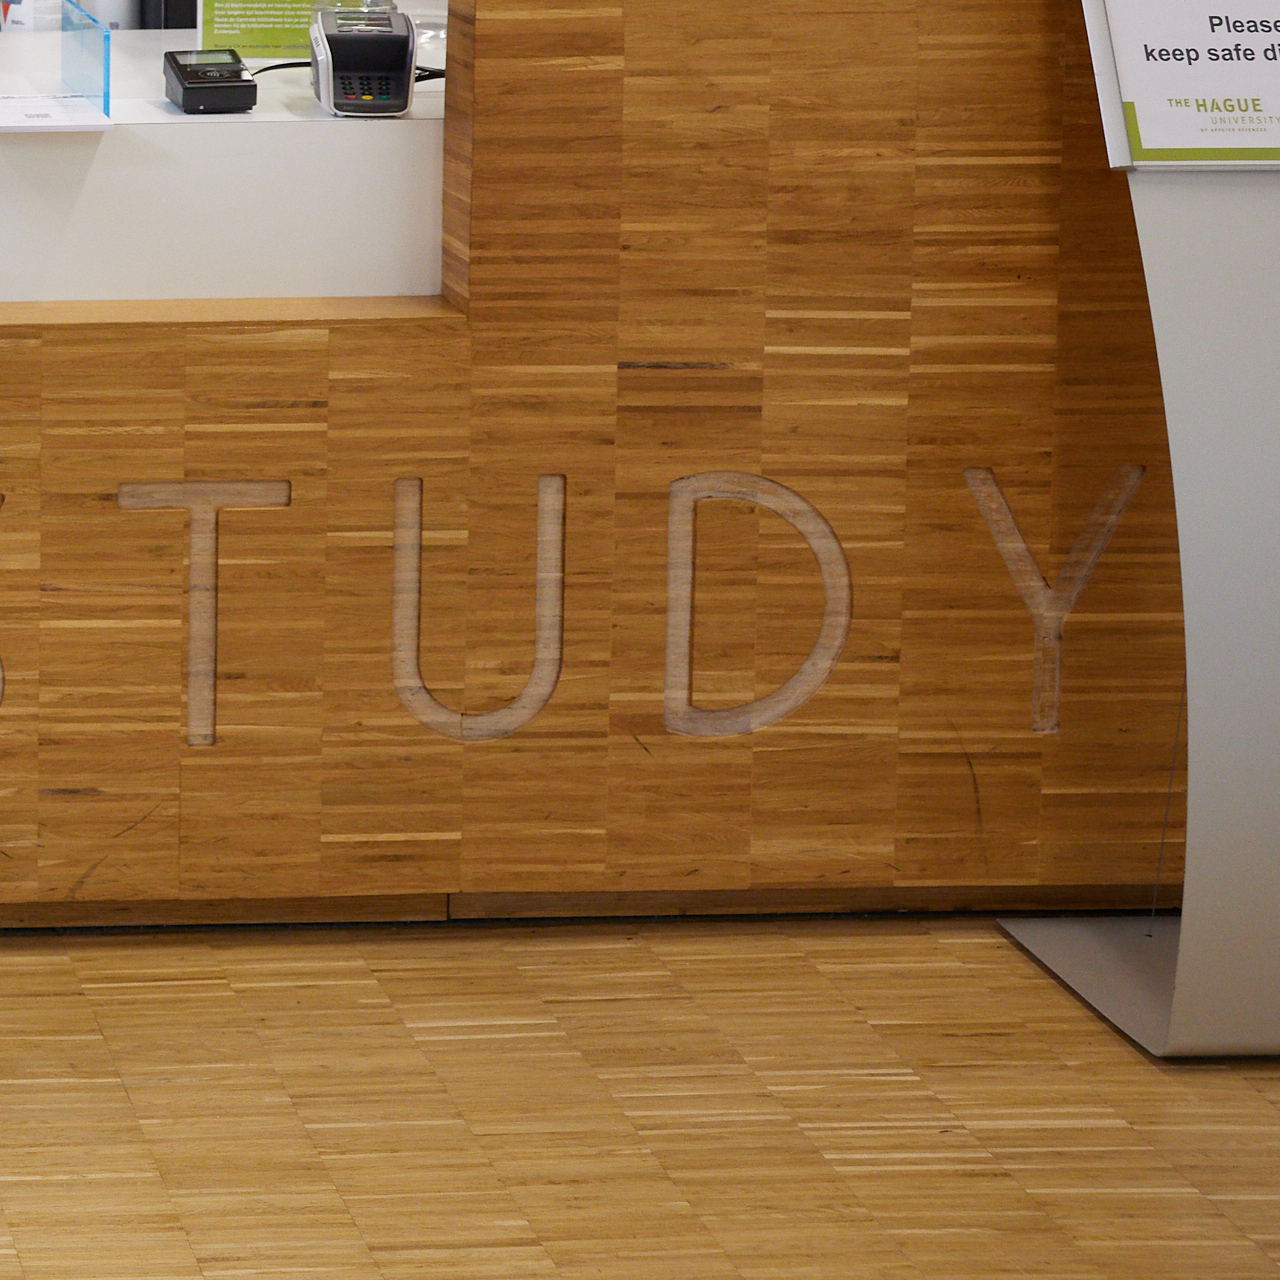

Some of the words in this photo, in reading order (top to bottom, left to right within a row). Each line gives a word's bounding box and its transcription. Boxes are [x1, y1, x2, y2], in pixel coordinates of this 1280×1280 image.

[1143, 43, 1200, 66] keep
[1207, 43, 1256, 62] safe
[1166, 98, 1191, 108] THE
[1195, 98, 1263, 113] HAGUE
